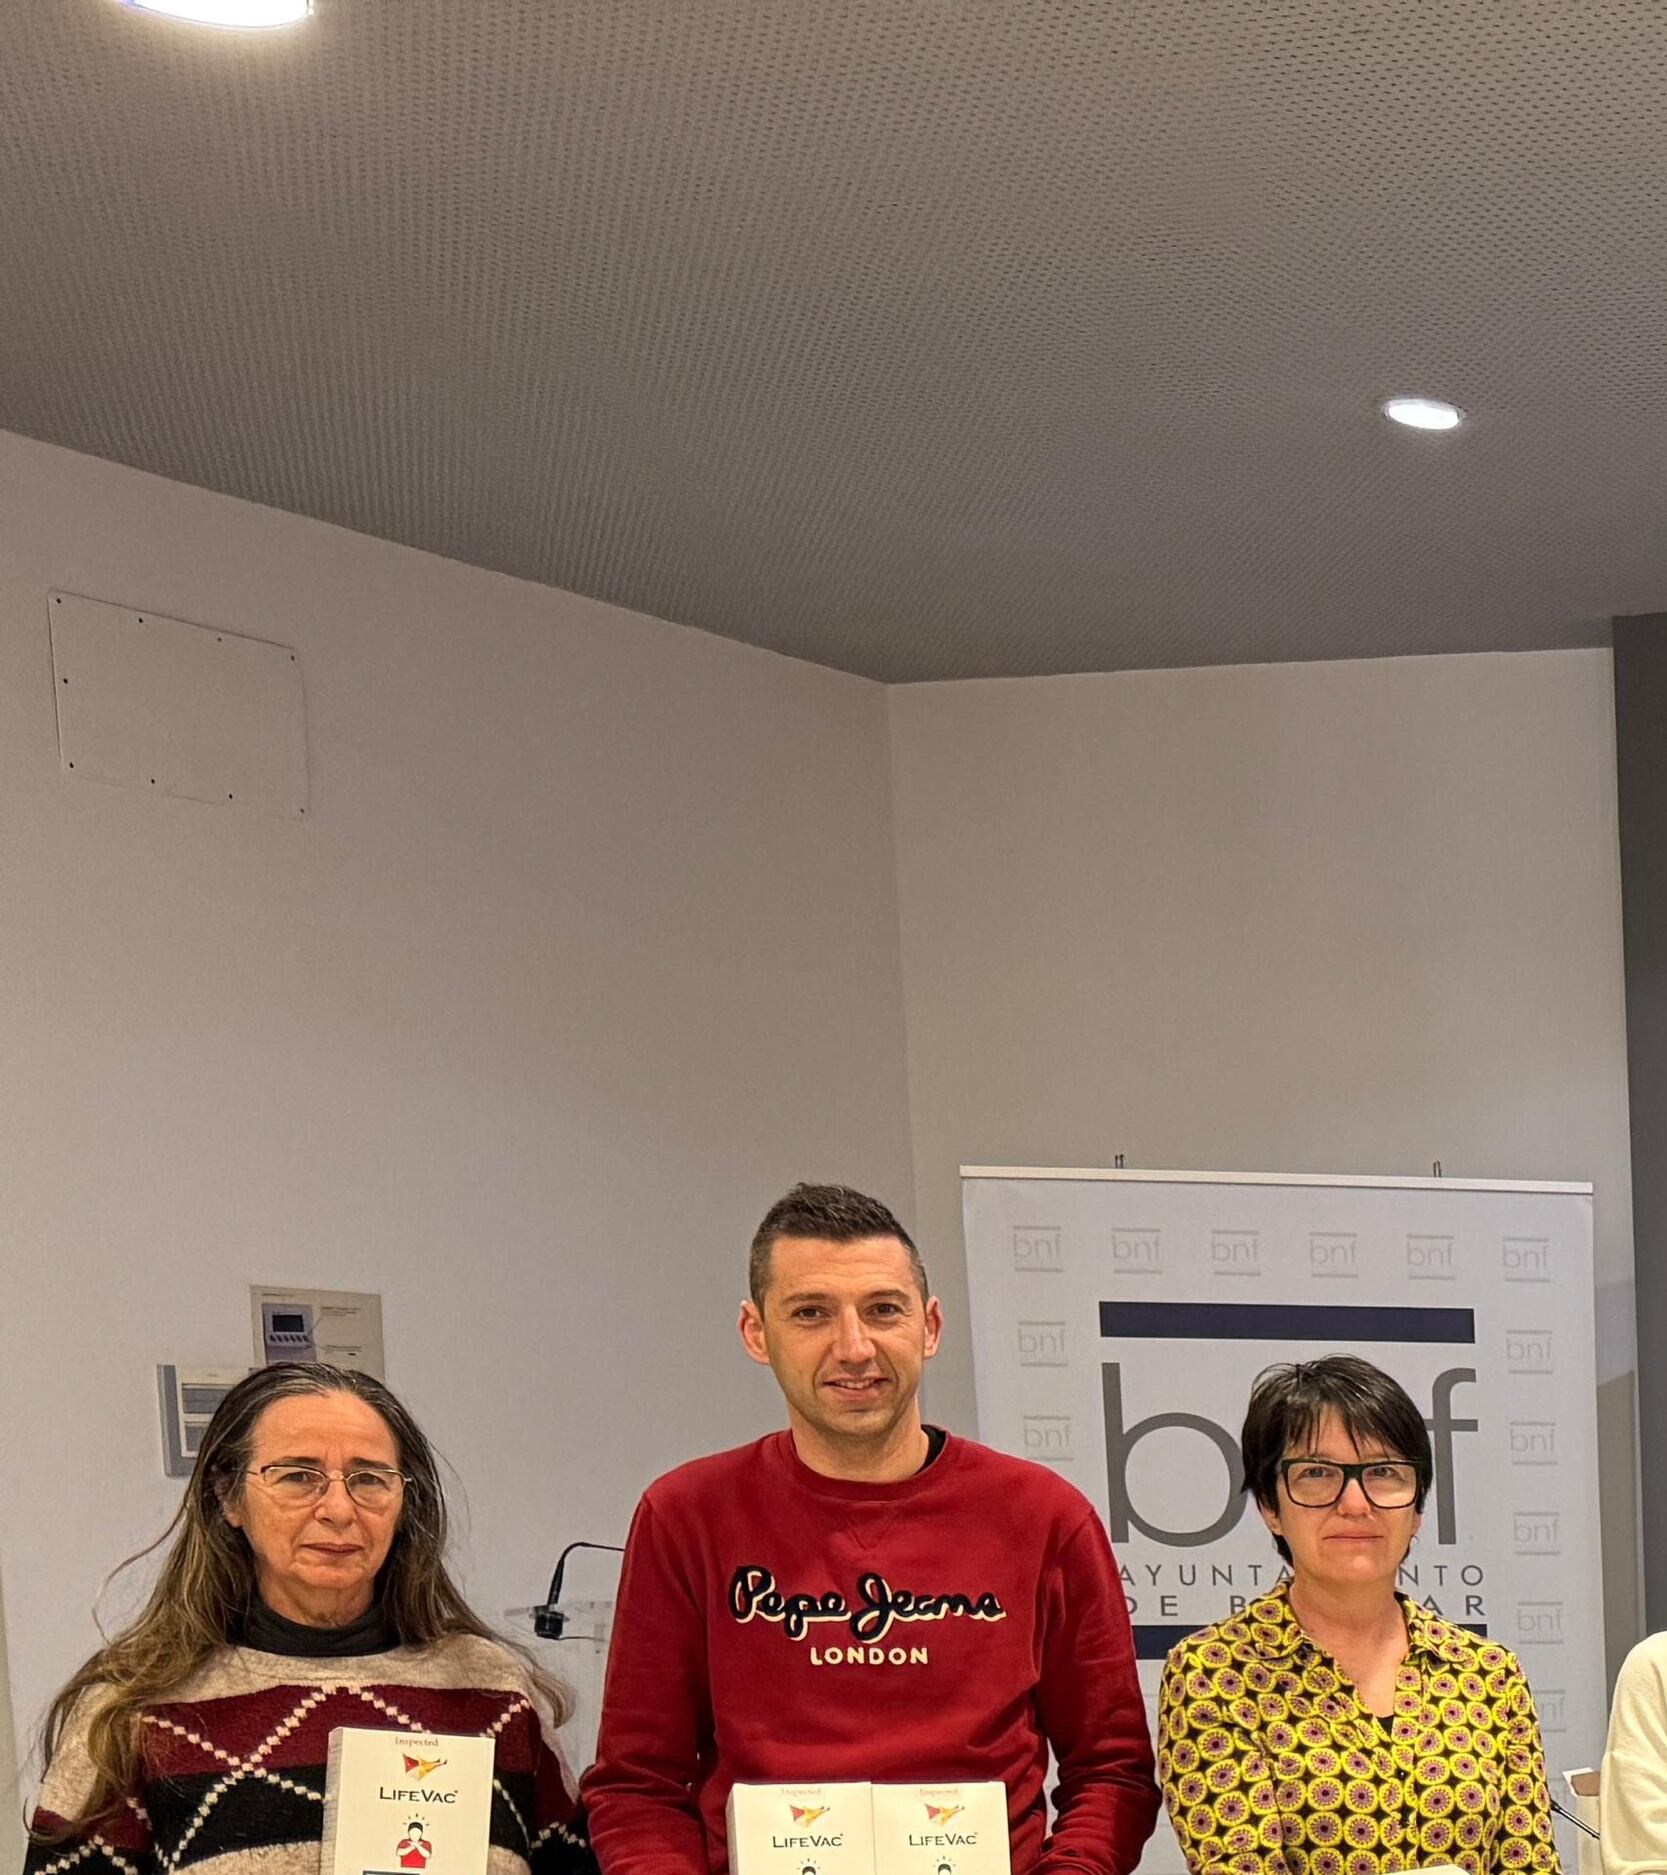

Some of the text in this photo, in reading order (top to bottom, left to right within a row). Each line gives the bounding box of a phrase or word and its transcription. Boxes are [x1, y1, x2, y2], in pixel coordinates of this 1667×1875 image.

[1012, 1231, 1062, 1259] bnf
[1111, 1233, 1162, 1262] bnf
[1210, 1235, 1260, 1263] bnf
[1310, 1238, 1357, 1265] bnf
[1407, 1241, 1454, 1267] bnf
[1502, 1243, 1549, 1269] bnf
[1102, 1361, 1479, 1548] bf
[1119, 1564, 1483, 1587] AYUNTANTO
[729, 1565, 1007, 1644] Pepe Jeans
[810, 1646, 929, 1666] LONDON
